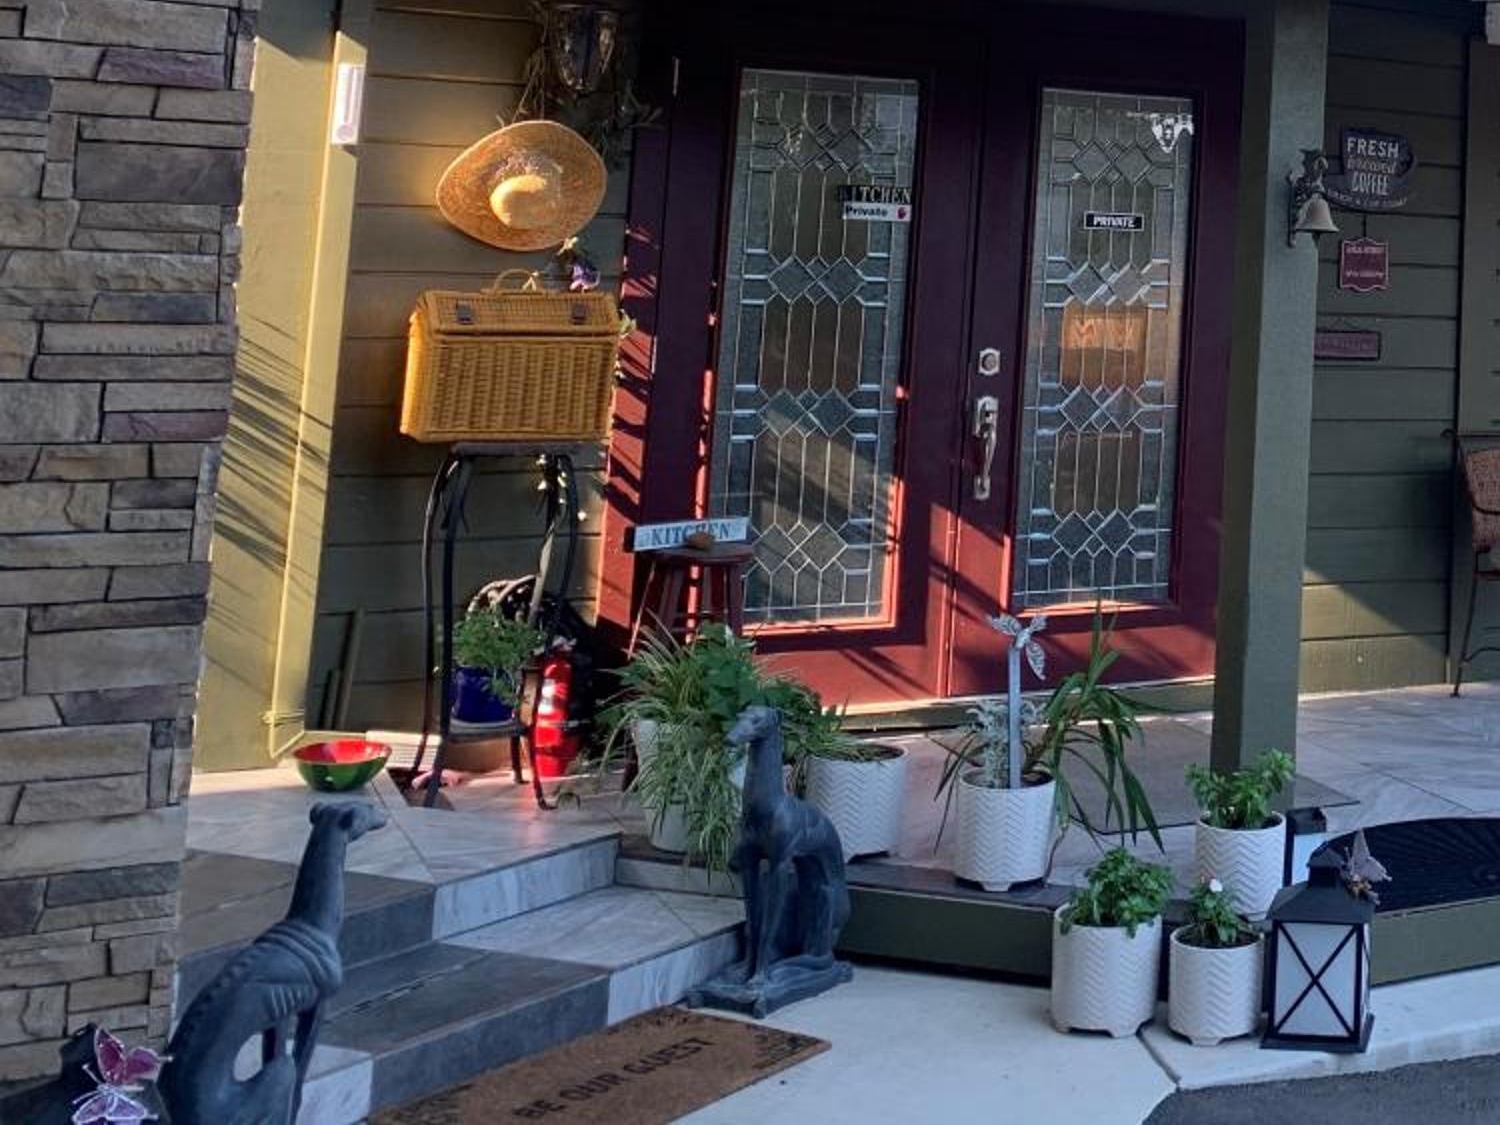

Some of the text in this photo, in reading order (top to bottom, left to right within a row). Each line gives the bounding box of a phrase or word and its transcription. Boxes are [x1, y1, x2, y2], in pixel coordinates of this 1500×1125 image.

[1346, 137, 1399, 158] FRESH
[1351, 170, 1389, 196] COFFEE
[845, 205, 889, 218] Private
[1093, 215, 1137, 228] PRIVATE
[513, 1036, 716, 1120] BE OUR GUEST
